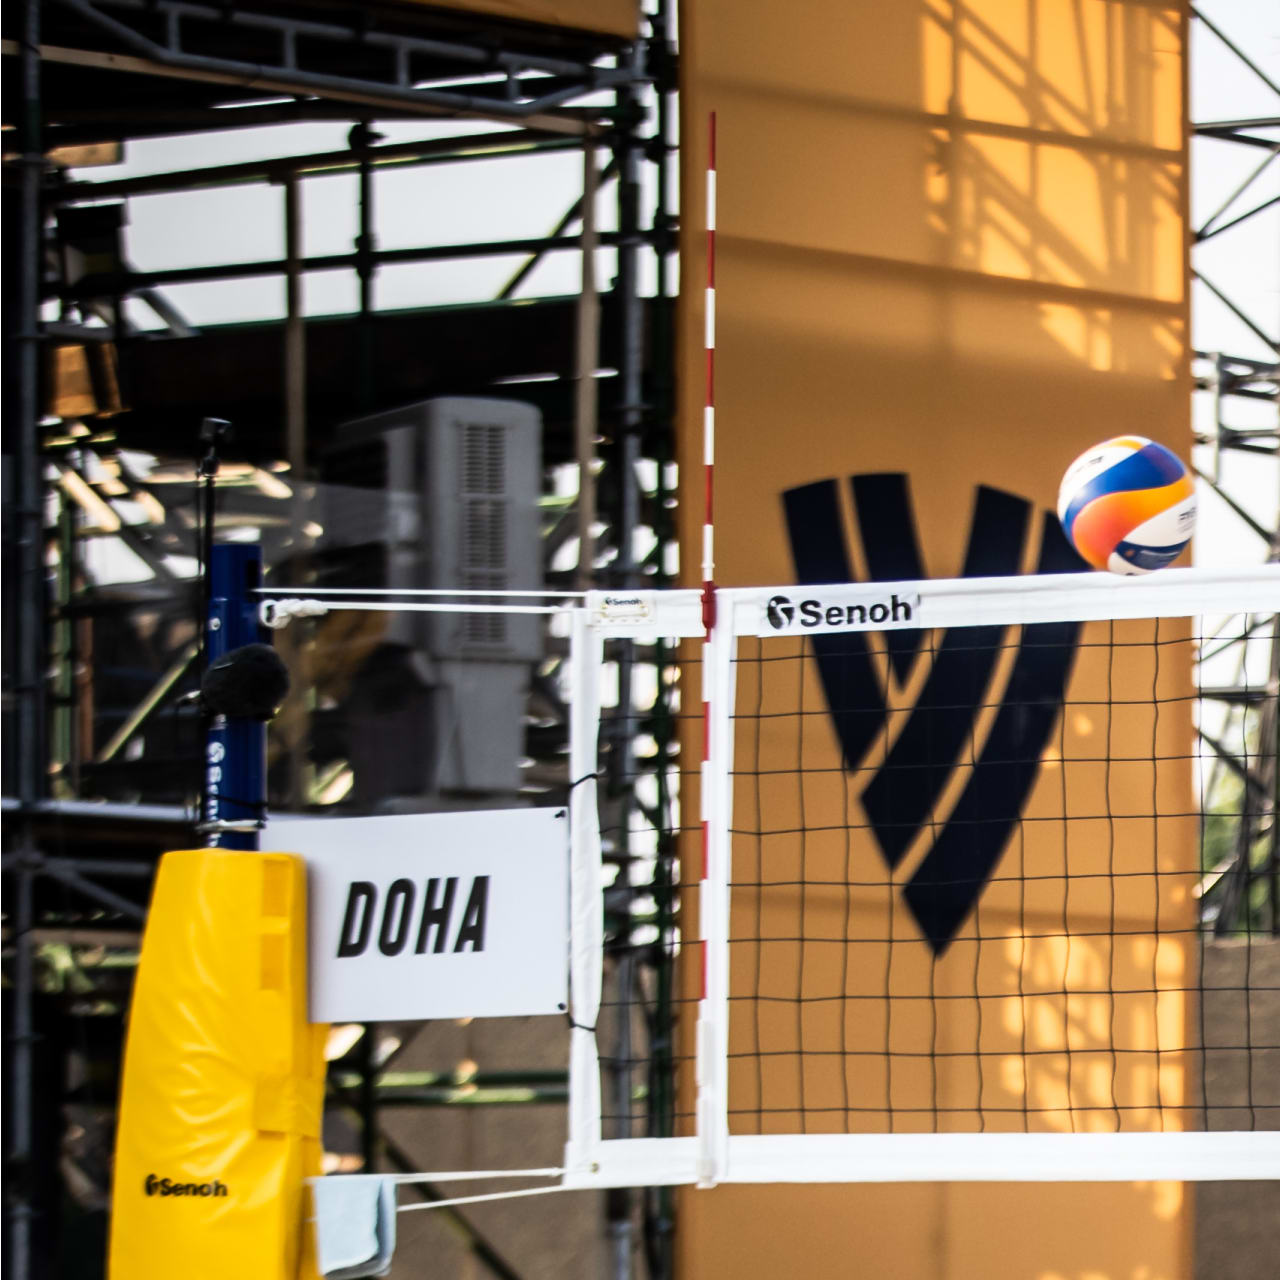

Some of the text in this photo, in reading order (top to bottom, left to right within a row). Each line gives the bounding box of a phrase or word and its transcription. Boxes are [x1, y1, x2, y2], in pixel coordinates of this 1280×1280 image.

[799, 594, 913, 627] Senoh
[337, 875, 491, 959] DOHA
[160, 1177, 228, 1197] Senoh
